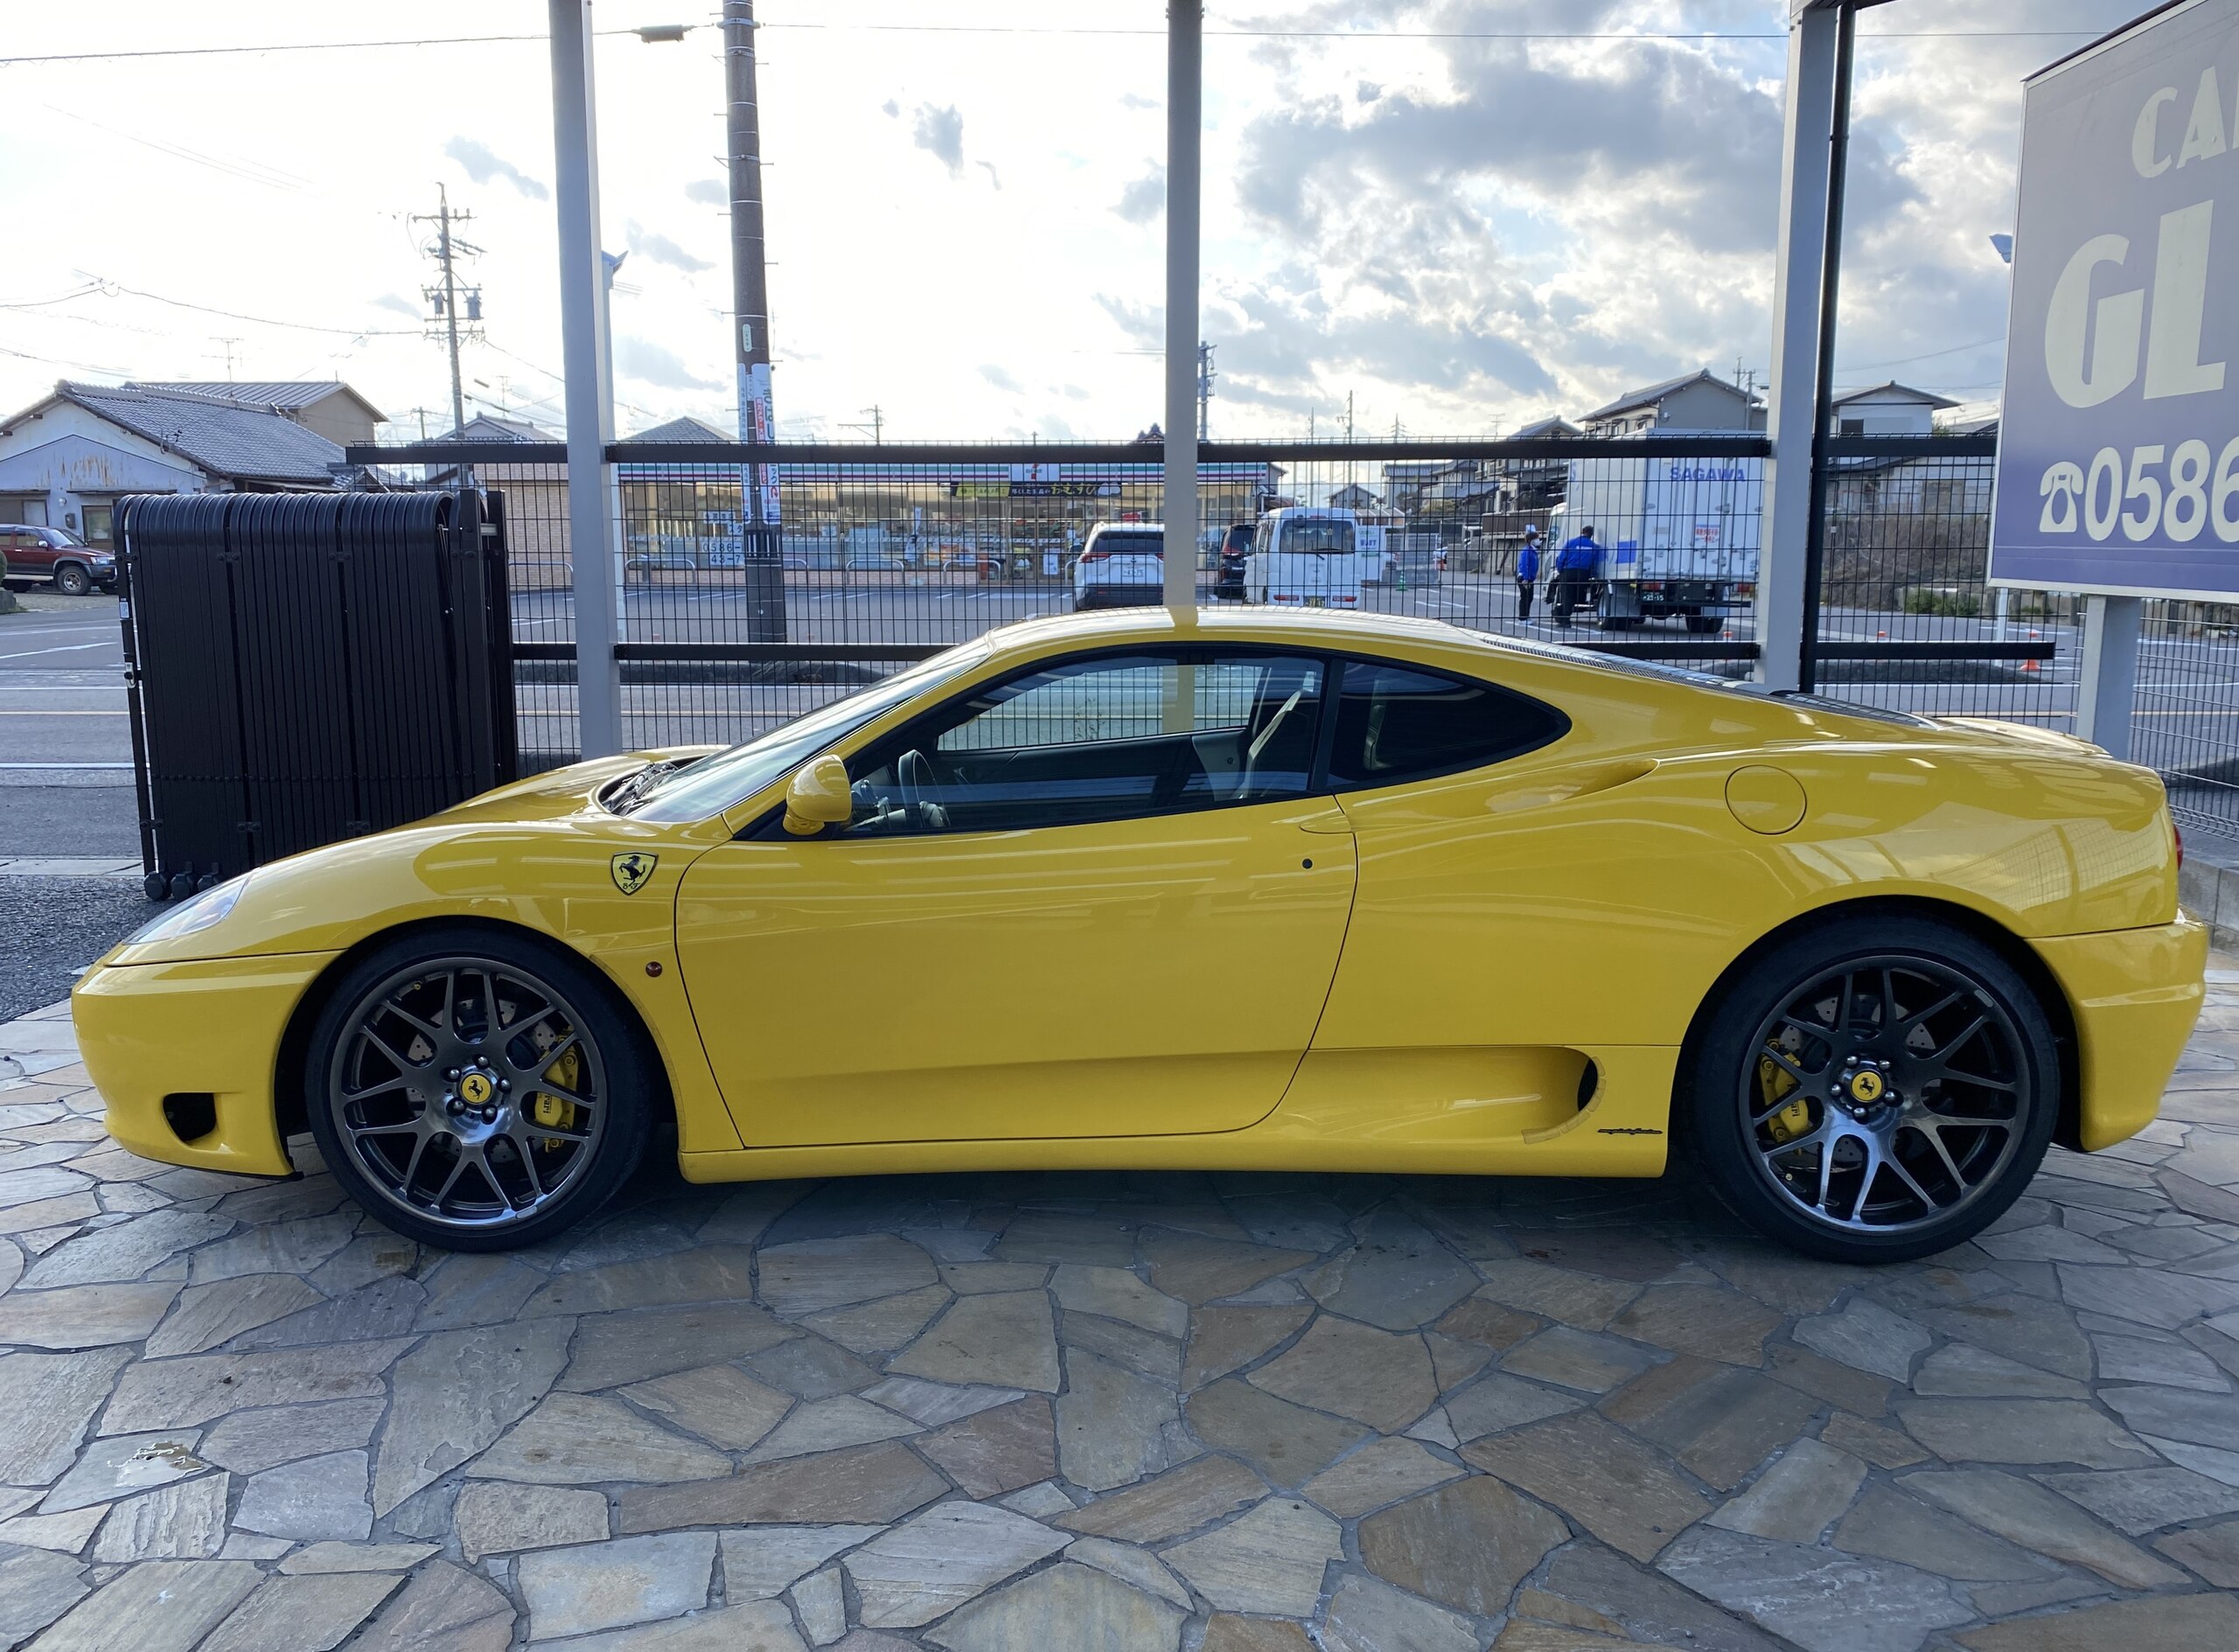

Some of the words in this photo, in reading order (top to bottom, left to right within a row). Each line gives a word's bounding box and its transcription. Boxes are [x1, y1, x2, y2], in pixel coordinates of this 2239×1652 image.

[2132, 65, 2239, 178] CA
[2045, 199, 2226, 408] GL
[1670, 467, 1745, 482] SAGAWA
[2084, 436, 2239, 542] 0586
